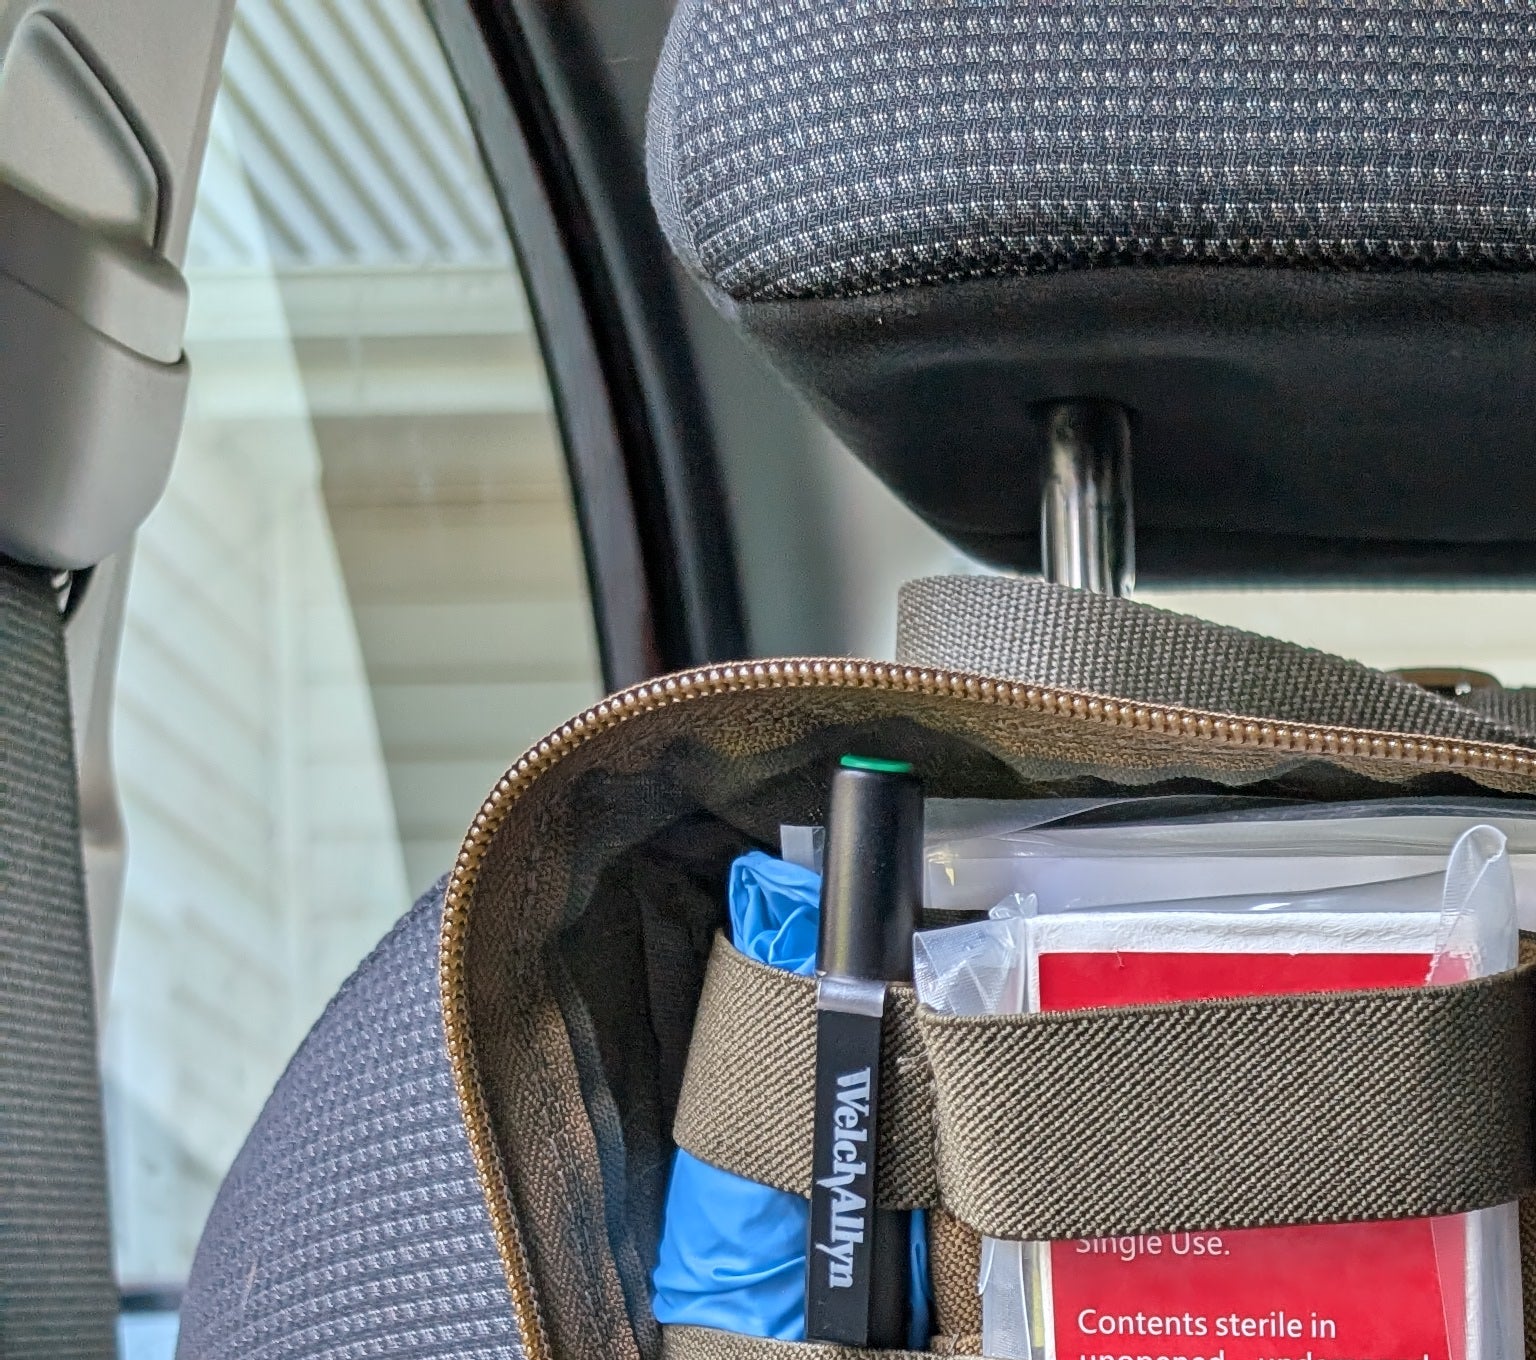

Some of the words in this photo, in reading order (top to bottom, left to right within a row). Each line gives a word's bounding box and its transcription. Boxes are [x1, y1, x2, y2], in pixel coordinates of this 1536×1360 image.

[1075, 1234, 1163, 1261] Single
[1171, 1232, 1231, 1256] Use.
[1077, 1308, 1208, 1337] Contents
[1215, 1310, 1303, 1338] sterile
[1311, 1311, 1337, 1339] in
